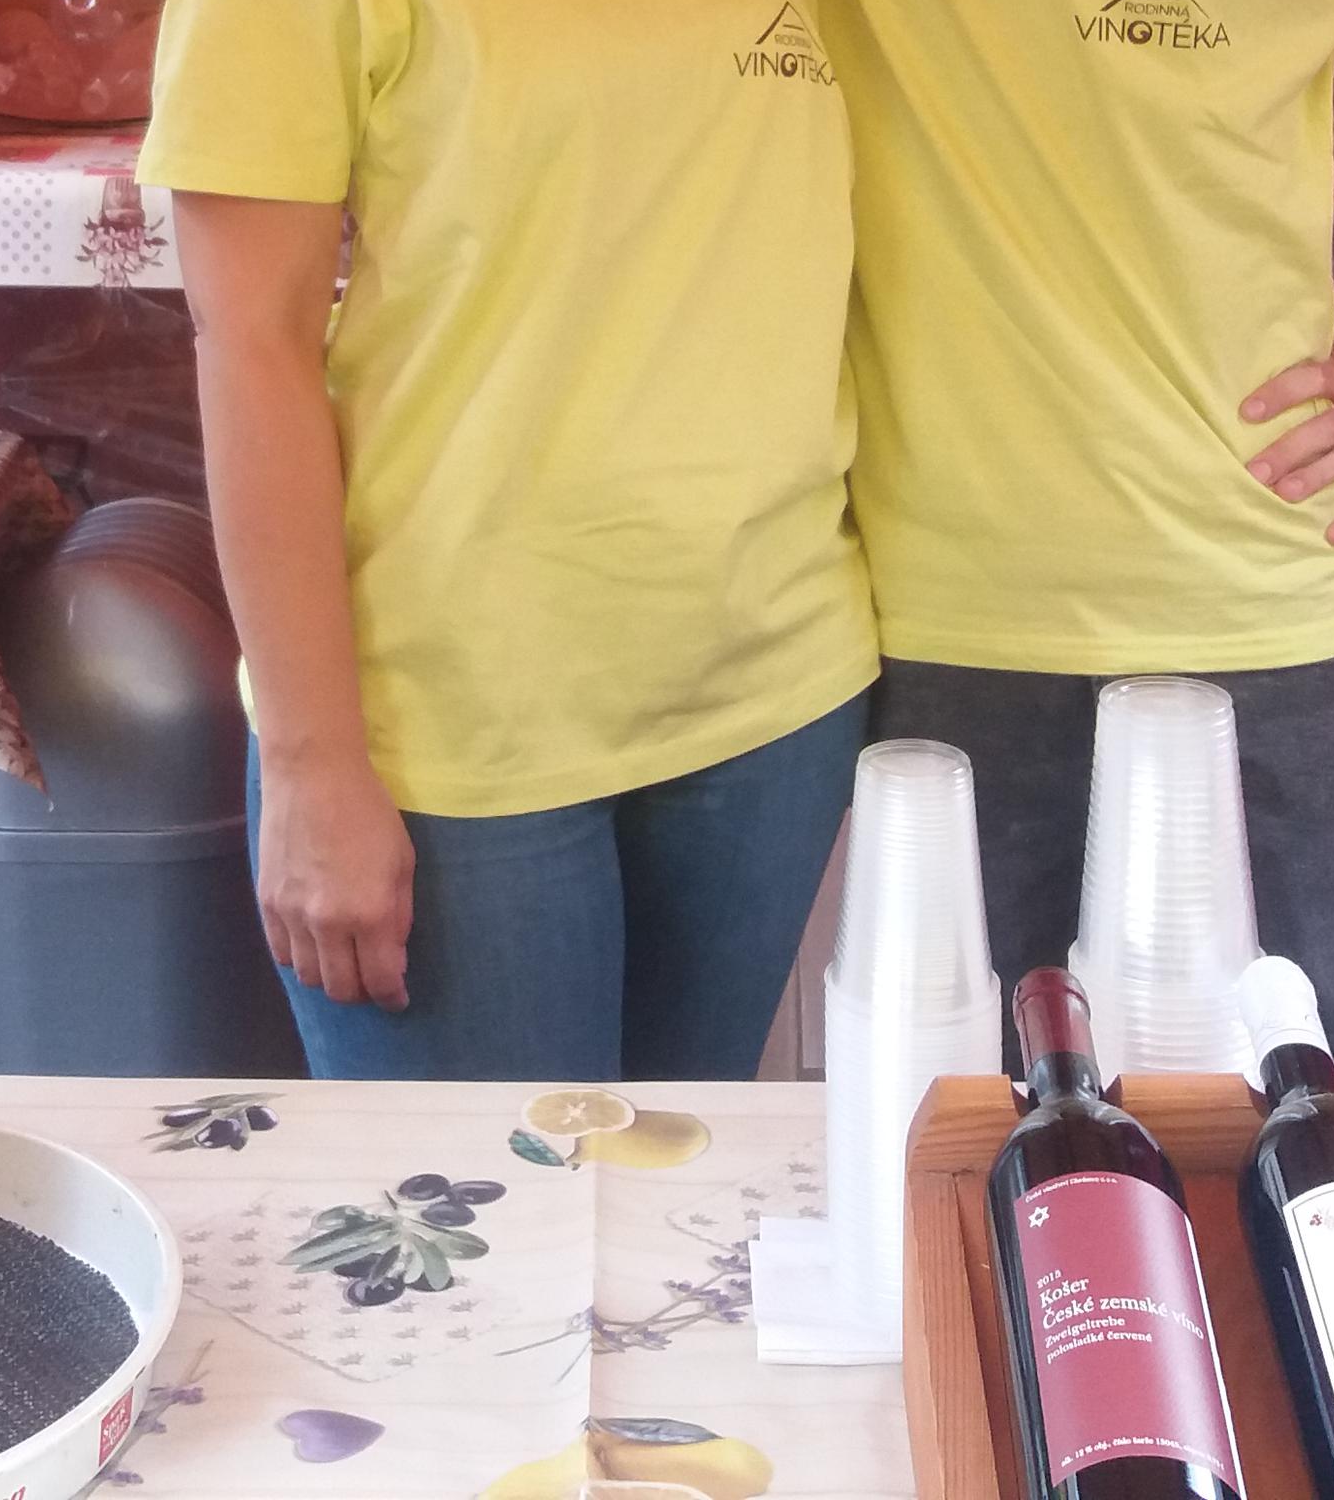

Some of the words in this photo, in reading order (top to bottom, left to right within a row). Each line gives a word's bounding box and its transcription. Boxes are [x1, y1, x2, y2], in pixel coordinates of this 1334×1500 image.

[1123, 1, 1191, 18] RODINNÁ
[1073, 14, 1231, 50] VINOTÉKA
[1039, 1277, 1089, 1308] Košer
[1042, 1296, 1094, 1329] České
[1099, 1297, 1168, 1317] zemské
[1170, 1310, 1205, 1340] víno
[1044, 1315, 1126, 1348] Zweigeltrebe
[1045, 1332, 1104, 1364] polosladké
[1106, 1331, 1153, 1343] červené
